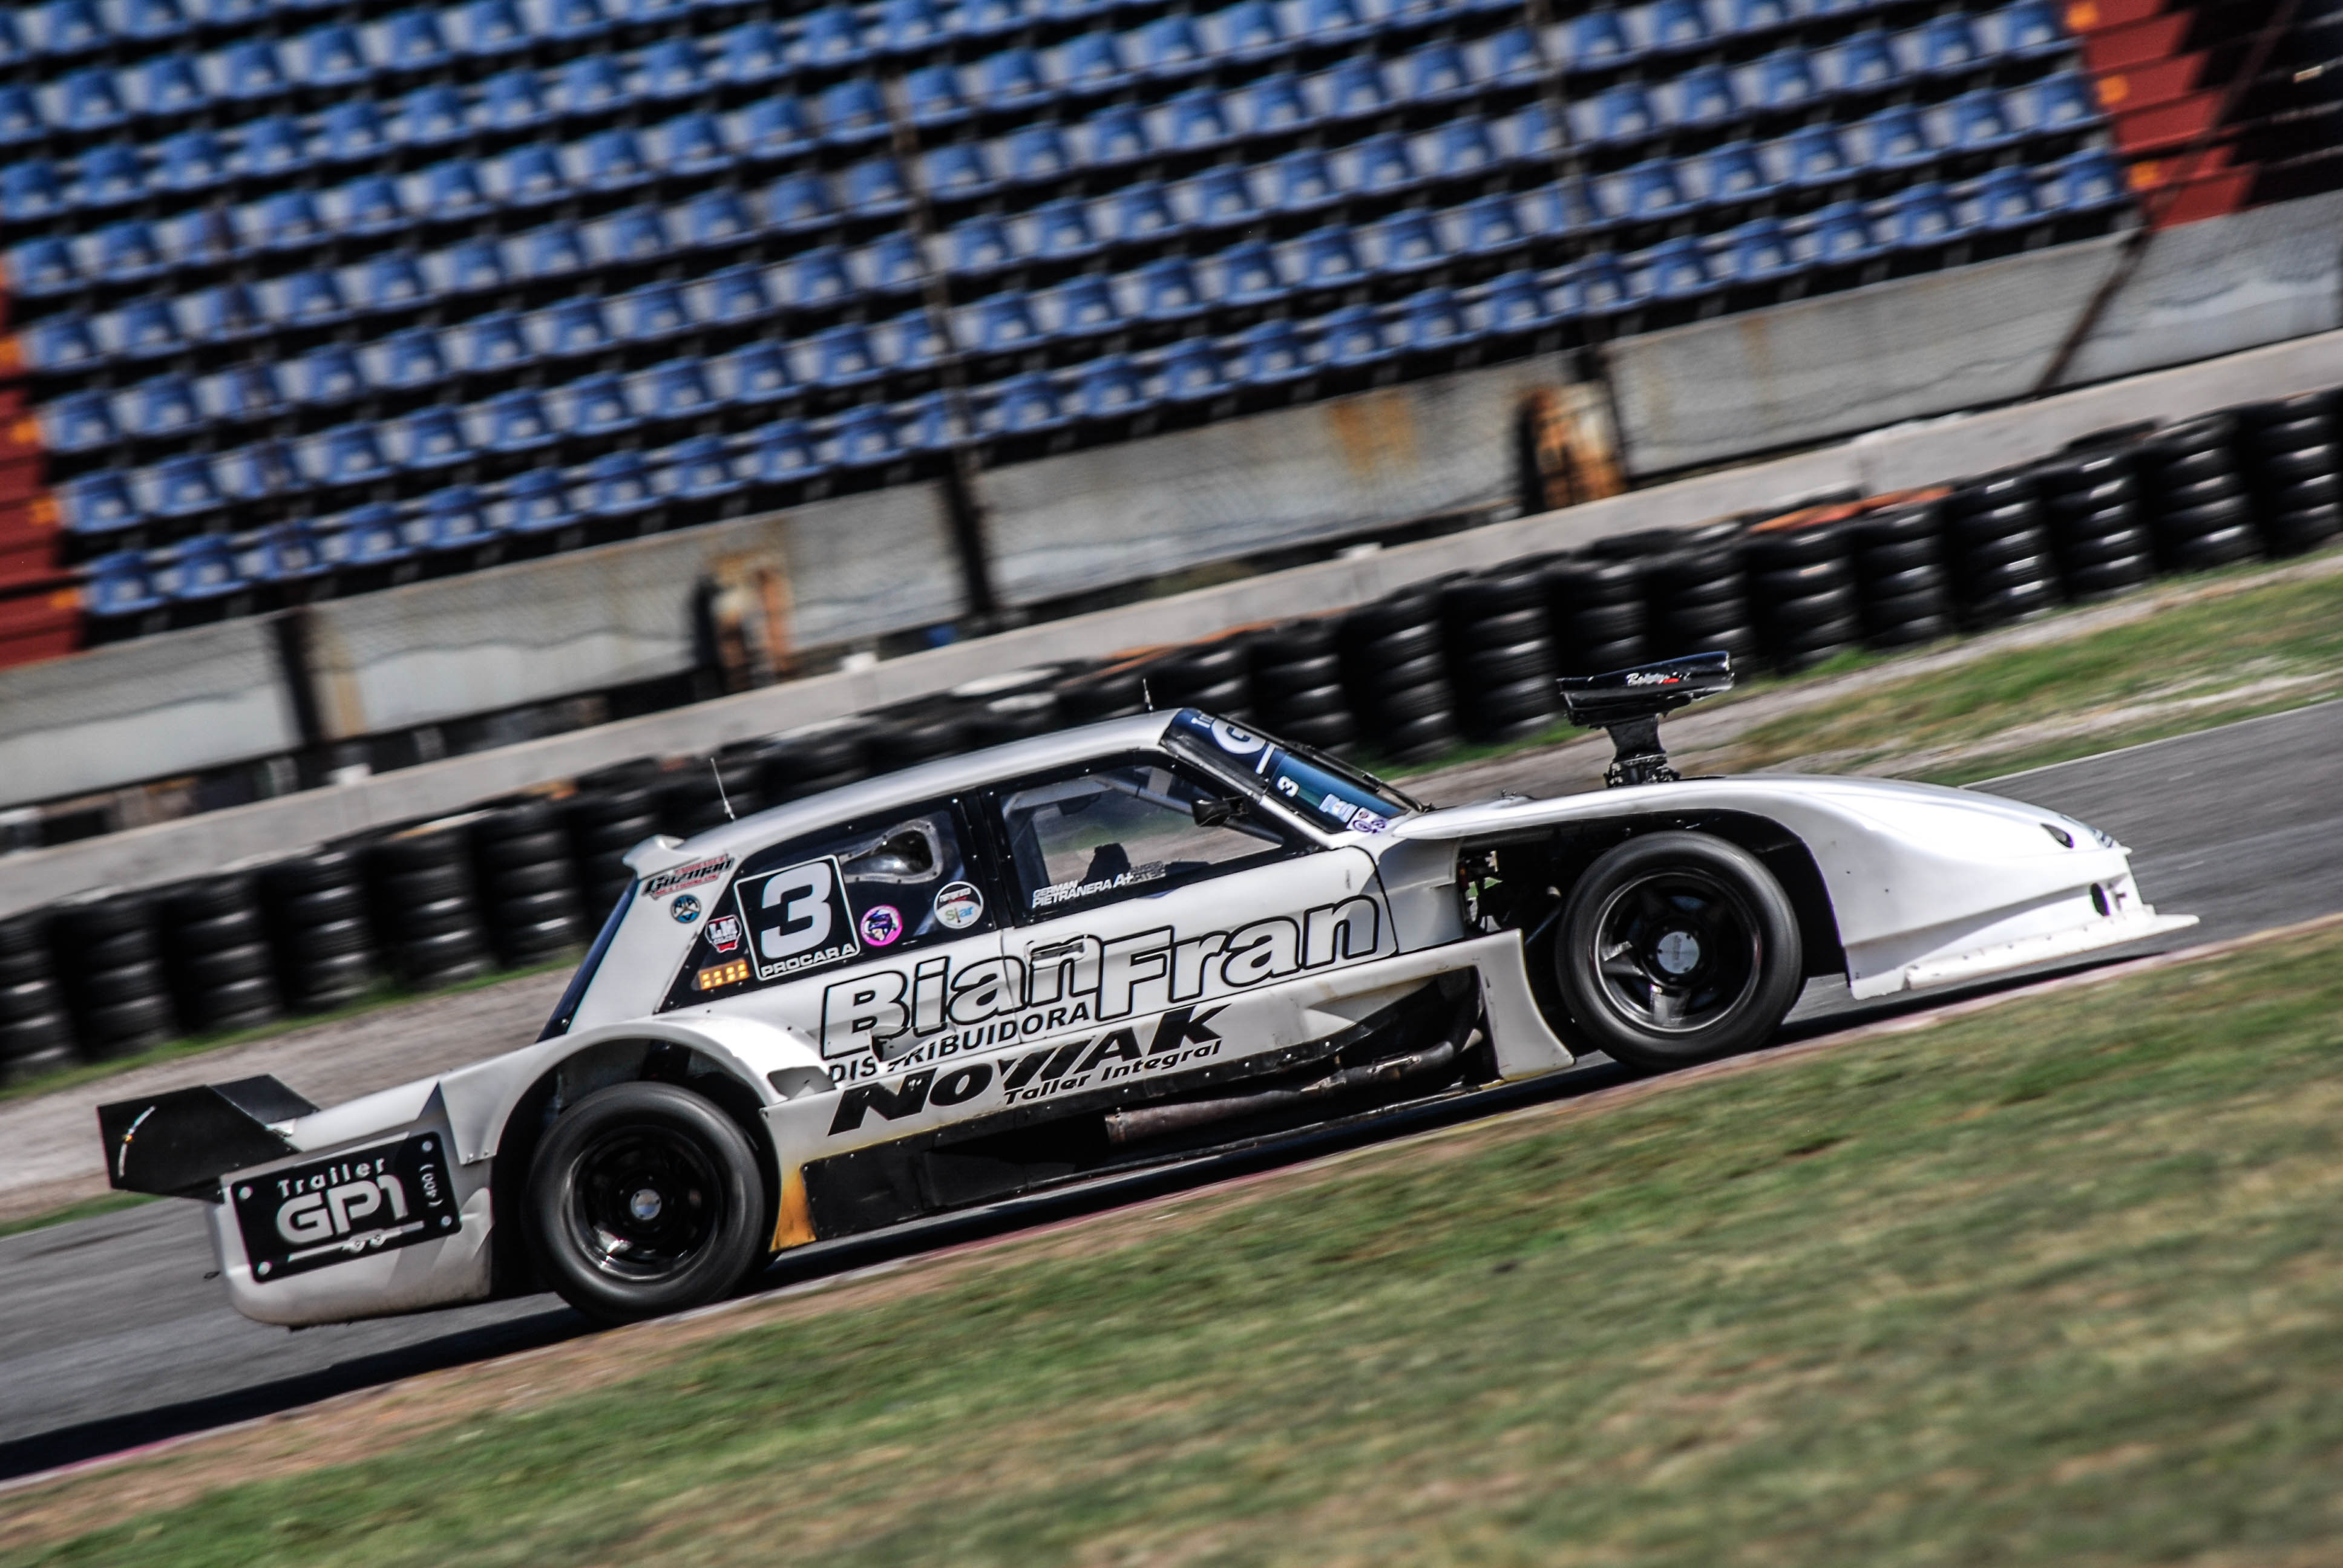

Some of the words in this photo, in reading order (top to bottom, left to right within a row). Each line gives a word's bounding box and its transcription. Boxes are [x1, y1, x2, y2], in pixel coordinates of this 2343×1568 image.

[761, 861, 831, 959] 3
[1032, 879, 1112, 908] PIETRANERA
[1033, 880, 1078, 897] GERMAN
[1004, 1073, 1090, 1105] Taller
[1101, 1039, 1222, 1082] Integral
[277, 1158, 385, 1198] Trailer
[277, 1174, 408, 1244] GP1
